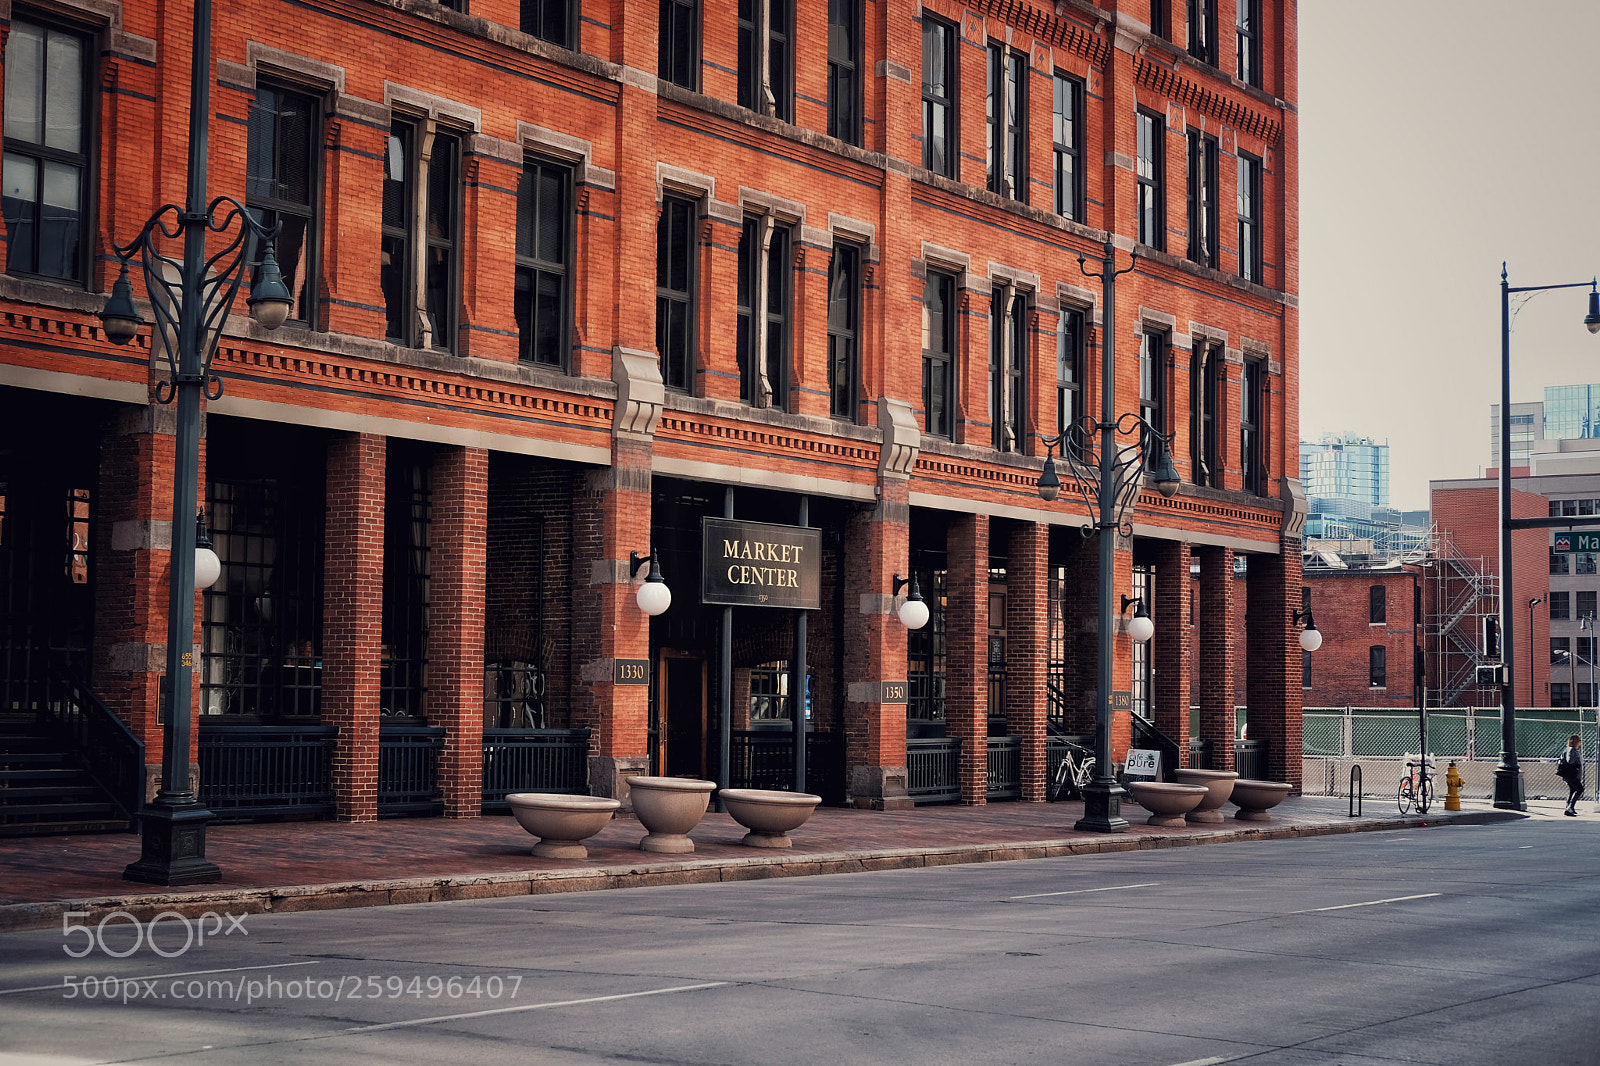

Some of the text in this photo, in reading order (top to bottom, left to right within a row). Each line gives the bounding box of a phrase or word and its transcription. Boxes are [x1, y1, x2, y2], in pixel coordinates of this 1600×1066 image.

[723, 539, 803, 564] MARKET
[727, 564, 799, 588] CENTER
[620, 664, 644, 679] 1330
[885, 685, 904, 699] 1350
[1115, 695, 1129, 706] 1380
[1127, 759, 1155, 770] pure
